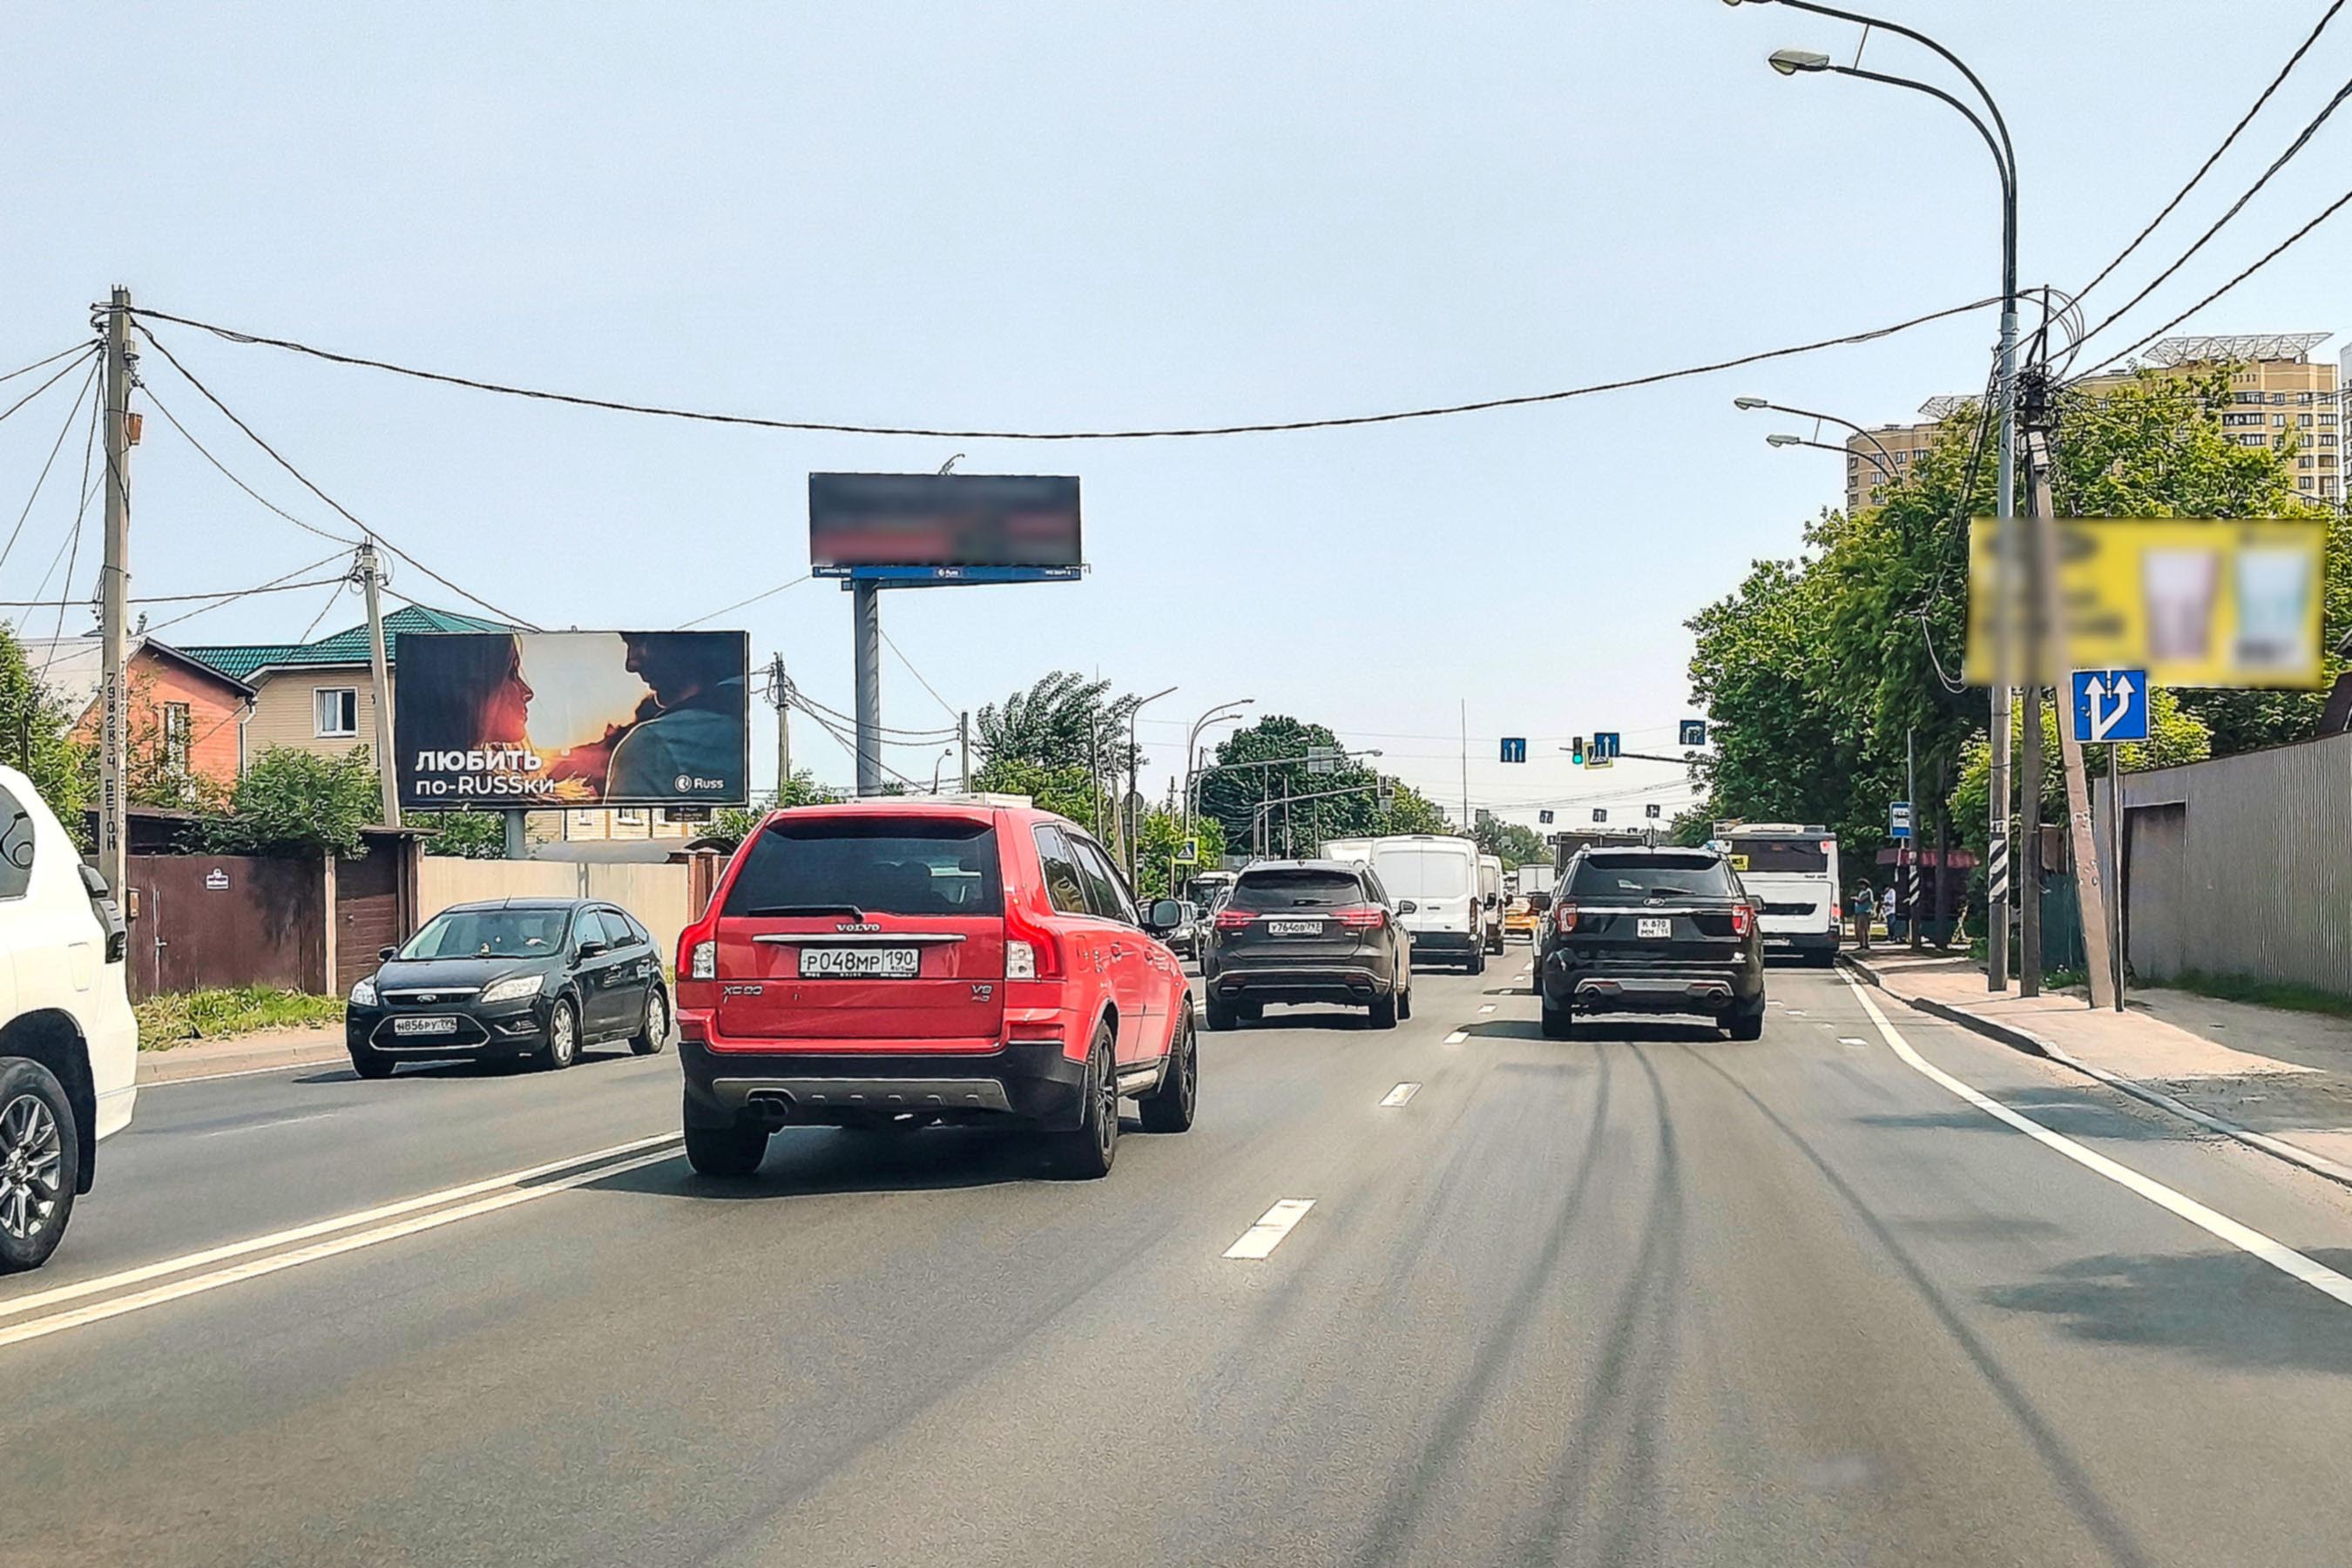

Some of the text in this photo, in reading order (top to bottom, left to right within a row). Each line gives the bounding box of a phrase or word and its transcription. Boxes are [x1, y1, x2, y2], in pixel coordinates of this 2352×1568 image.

[415, 750, 543, 772] ЛЮБИТЬ
[416, 775, 556, 795] по-RUSSки
[693, 777, 724, 789] Russ
